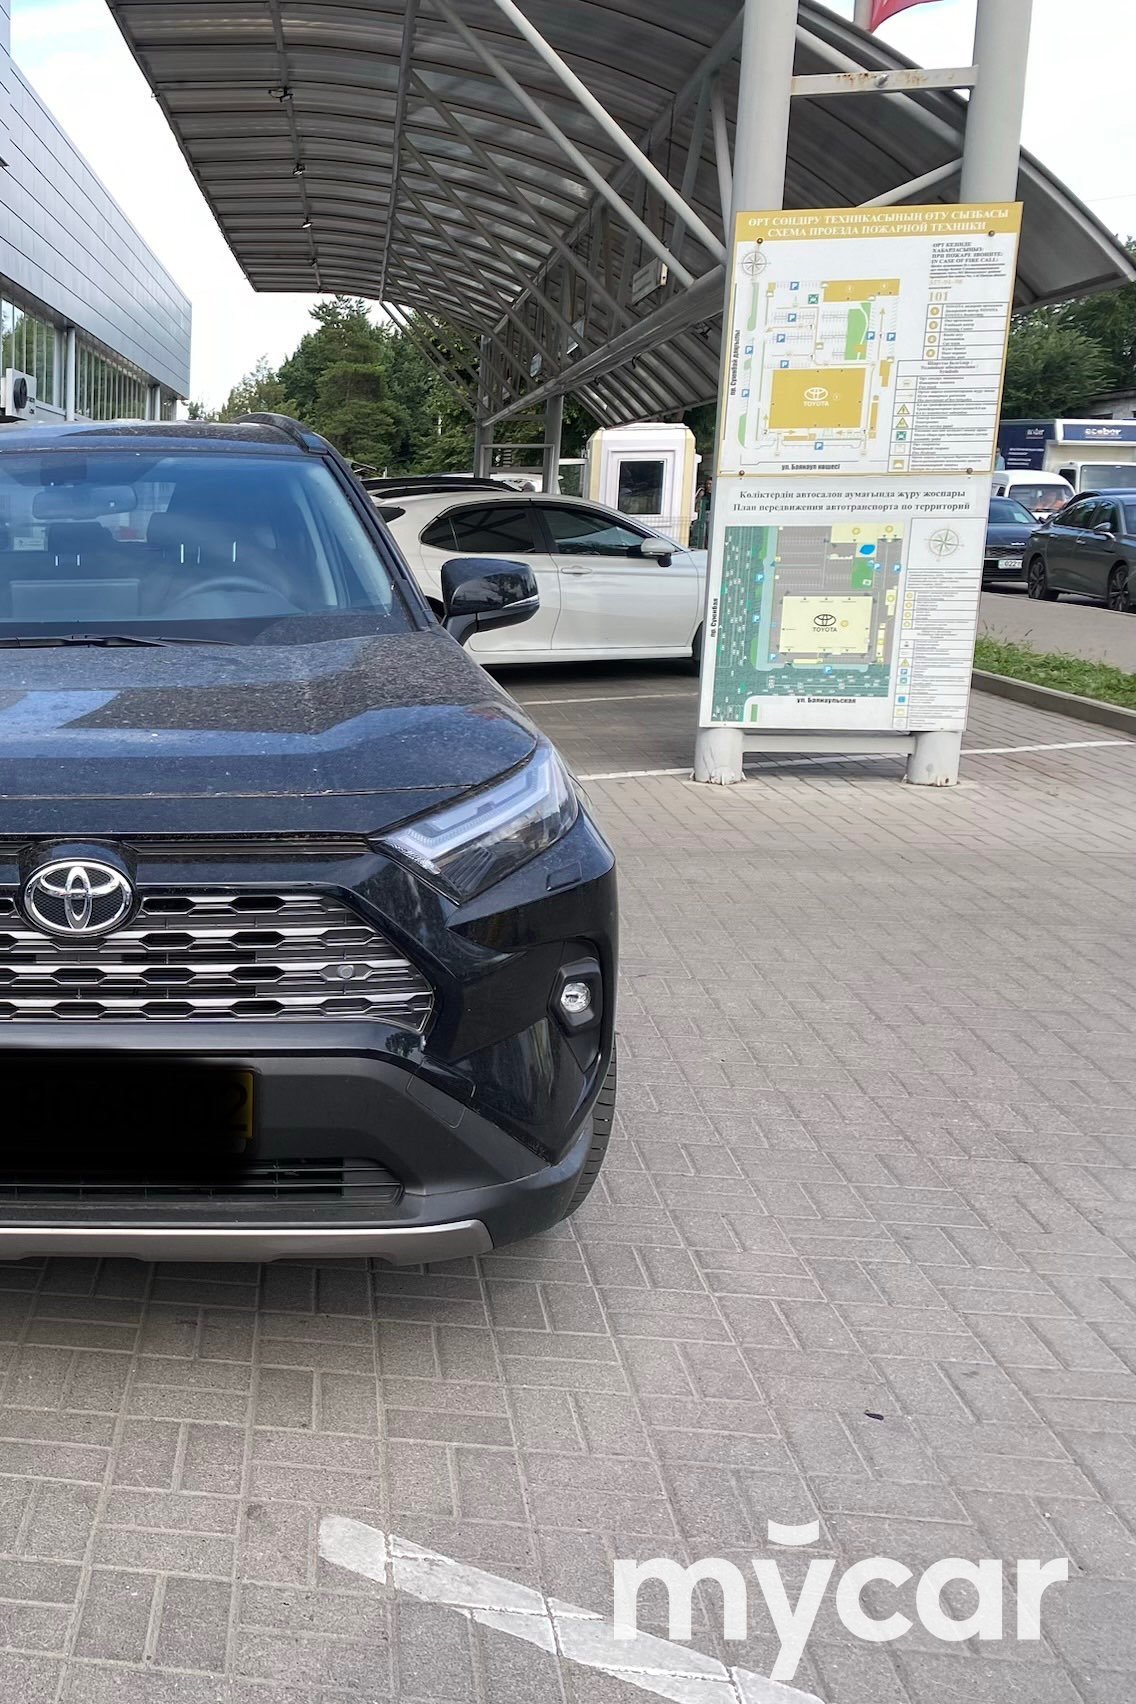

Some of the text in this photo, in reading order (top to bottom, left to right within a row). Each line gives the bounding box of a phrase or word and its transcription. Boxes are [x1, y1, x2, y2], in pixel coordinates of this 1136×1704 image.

[768, 221, 986, 237] СХЕМА ПРОЕЗДА ПОЖАРНОЙ ТЕХНИКИ
[923, 490, 966, 499] жоспары
[733, 503, 757, 511] План
[759, 504, 824, 513] передвижения
[825, 503, 899, 512] автотранспорта
[915, 502, 970, 512] территорий
